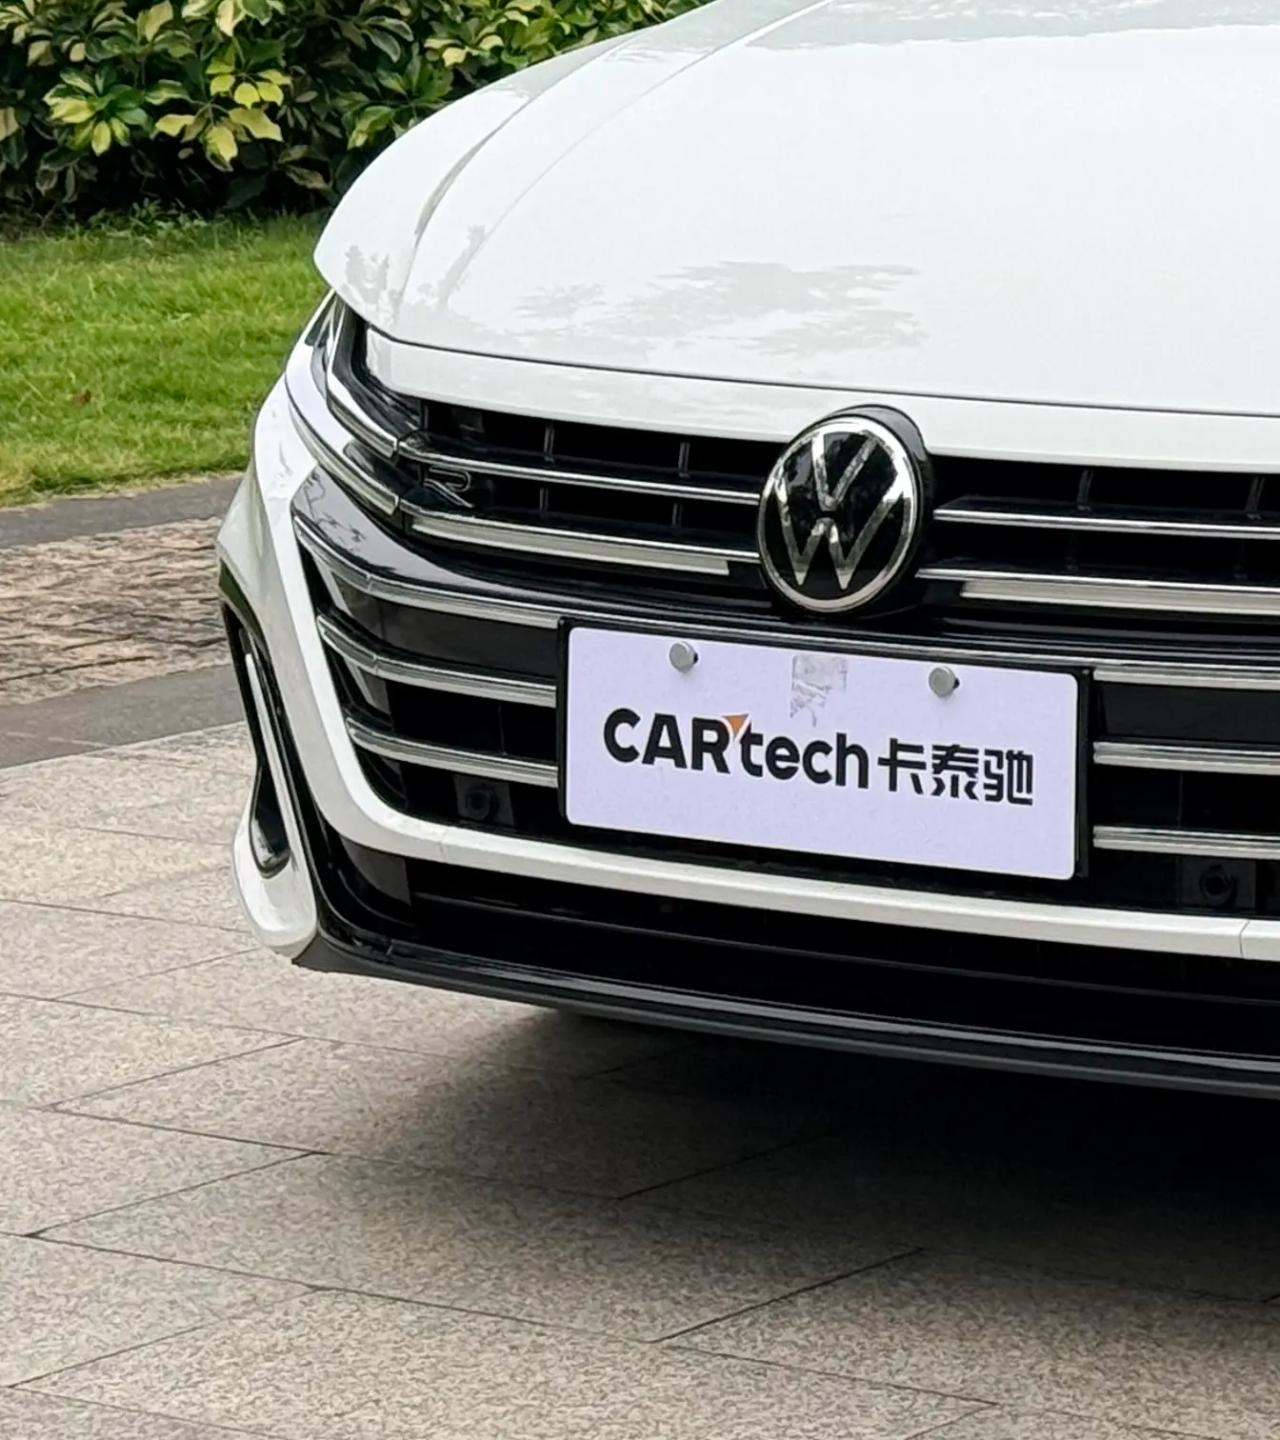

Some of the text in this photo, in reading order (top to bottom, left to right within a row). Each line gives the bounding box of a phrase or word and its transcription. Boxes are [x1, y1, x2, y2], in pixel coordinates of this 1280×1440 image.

[603, 707, 1034, 806] CARtech 卡泰驰
